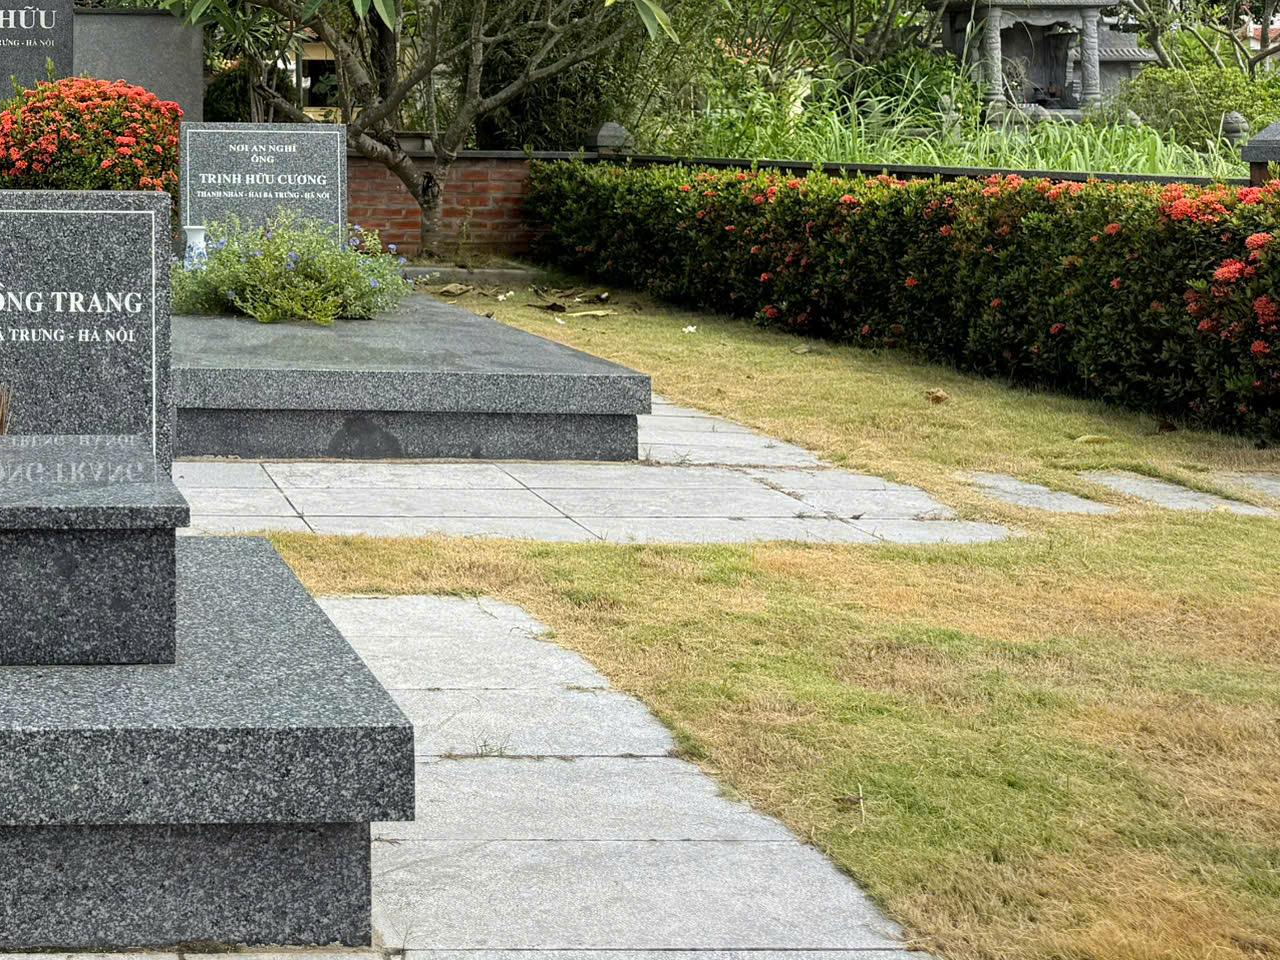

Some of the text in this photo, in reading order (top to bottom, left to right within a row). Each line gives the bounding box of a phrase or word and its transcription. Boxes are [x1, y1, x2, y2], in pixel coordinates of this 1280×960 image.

[251, 144, 266, 152] AN
[250, 154, 275, 163] ÔNG
[245, 172, 275, 184] HỮU
[50, 291, 143, 313] TRANG
[8, 327, 65, 342] TRƯNG
[78, 327, 101, 342] HÀ
